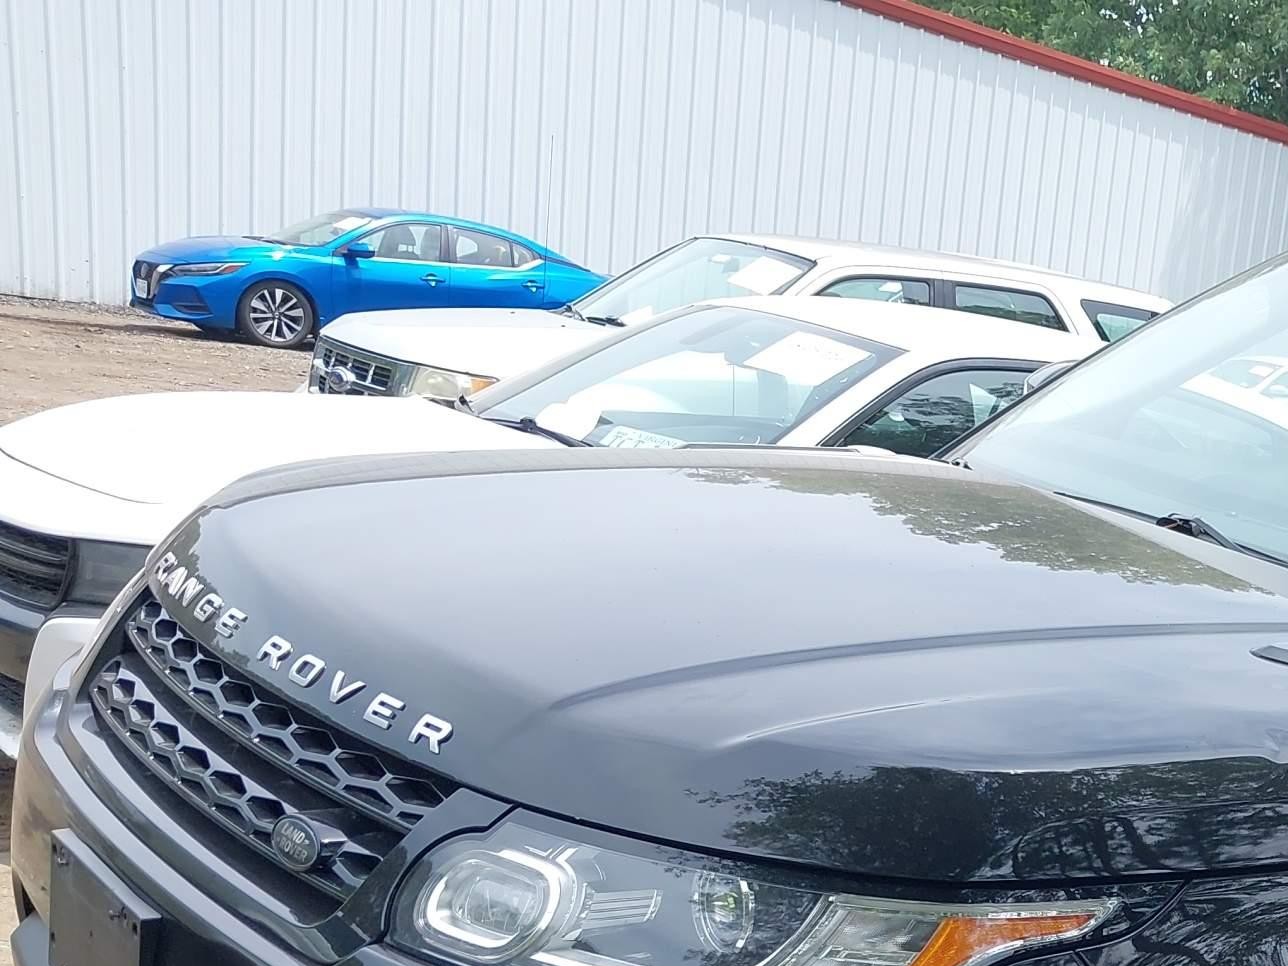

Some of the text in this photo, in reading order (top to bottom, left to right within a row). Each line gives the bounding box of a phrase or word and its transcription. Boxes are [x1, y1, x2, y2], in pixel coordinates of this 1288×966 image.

[154, 551, 455, 755] RANGE ROVER
[281, 822, 306, 844] LAND
[279, 838, 308, 862] ROVER
